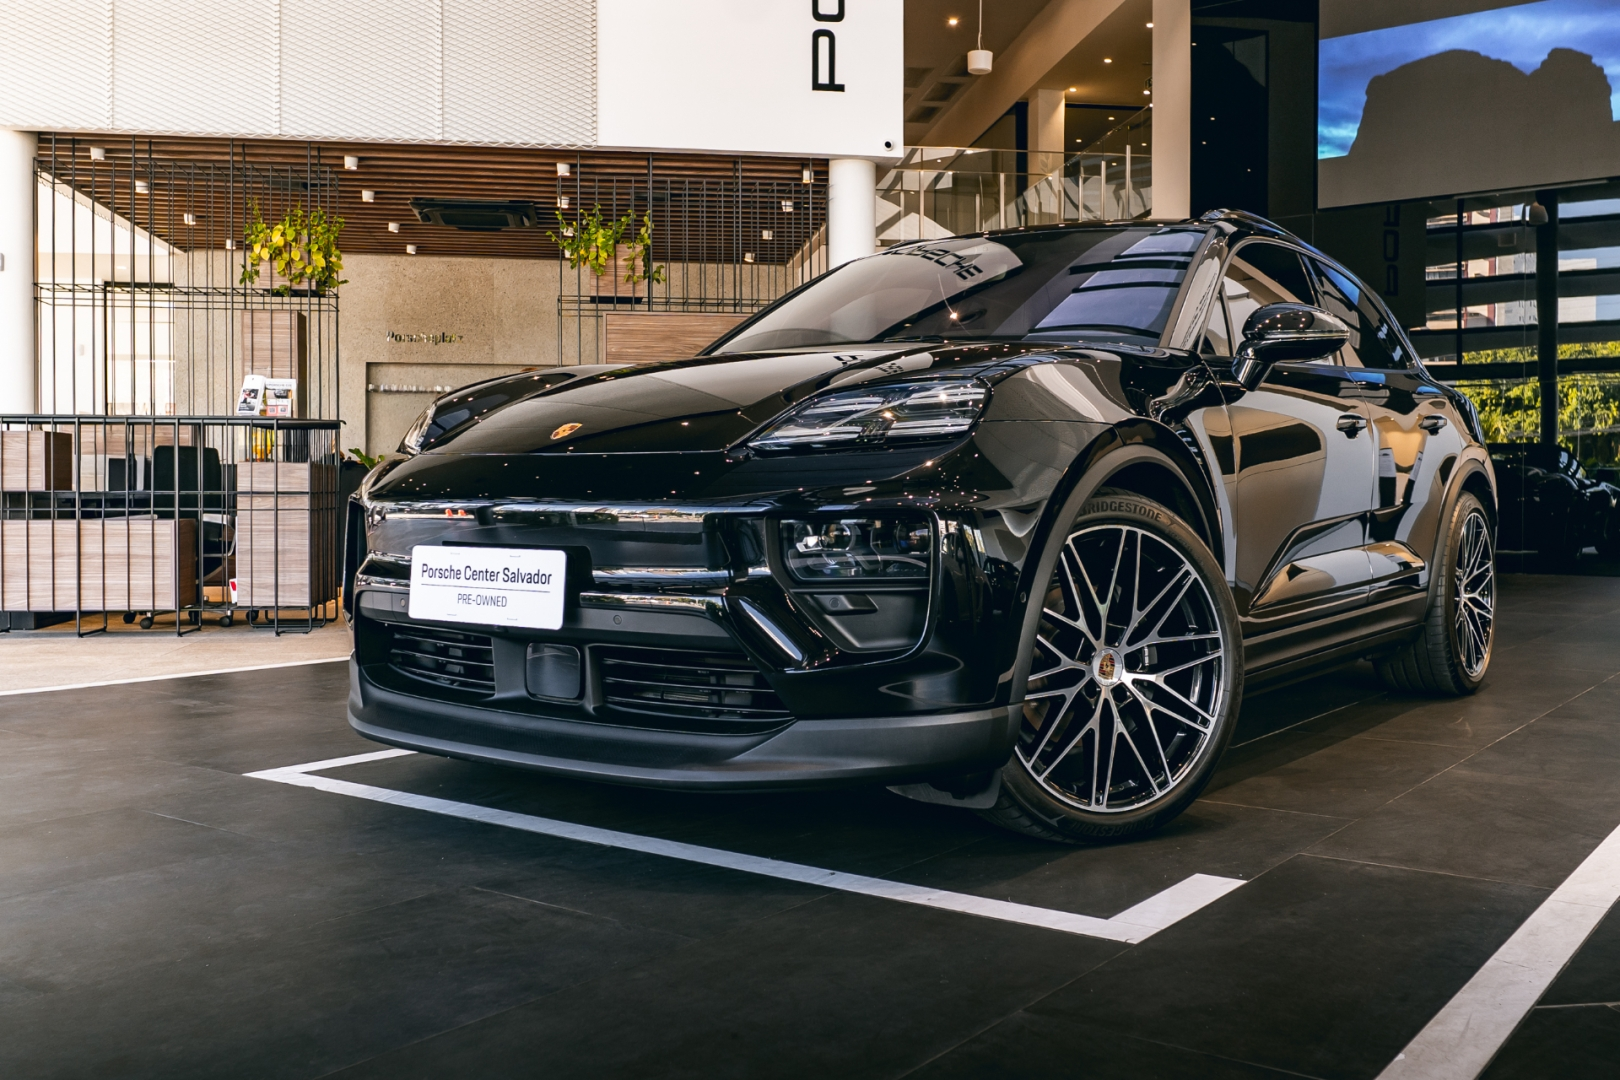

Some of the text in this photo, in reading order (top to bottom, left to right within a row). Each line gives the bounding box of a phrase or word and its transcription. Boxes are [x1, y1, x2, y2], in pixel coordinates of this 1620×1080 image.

[421, 563, 552, 585] Porsche Center Salvador
[457, 593, 508, 607] PRE-OWNED
